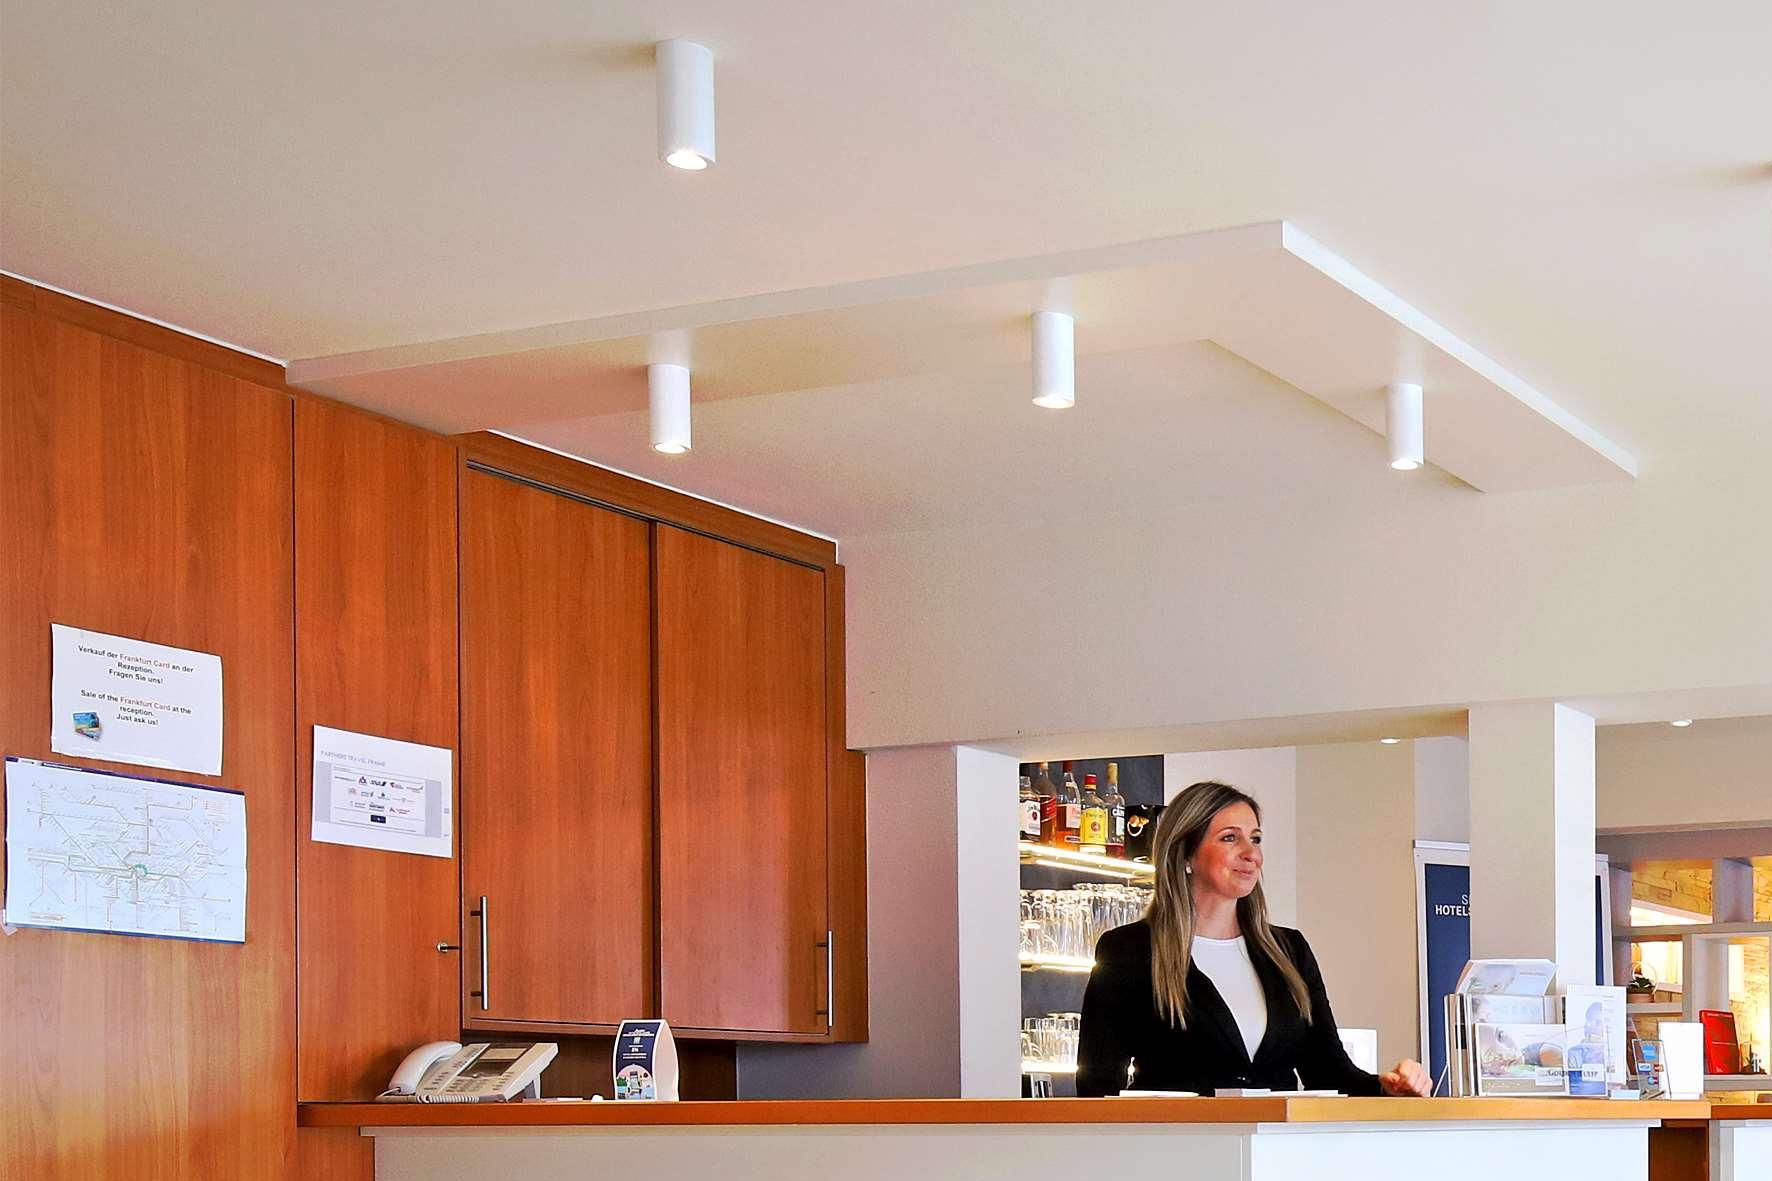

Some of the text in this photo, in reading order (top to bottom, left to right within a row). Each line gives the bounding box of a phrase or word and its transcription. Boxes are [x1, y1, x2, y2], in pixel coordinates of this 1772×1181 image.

[78, 645, 105, 657] Verkauf
[107, 651, 118, 659] der
[120, 653, 152, 665] Frankfurt
[153, 660, 170, 669] Card
[182, 665, 194, 673] der
[117, 662, 154, 675] Rezeption.
[109, 669, 163, 684] Fragen Sie uns!
[81, 690, 96, 698] Sale
[120, 696, 152, 708] Frankfurt
[154, 702, 171, 711] Card
[180, 706, 191, 714] the
[119, 706, 154, 716] reception.
[116, 714, 132, 722] Just
[1461, 894, 1470, 905] S
